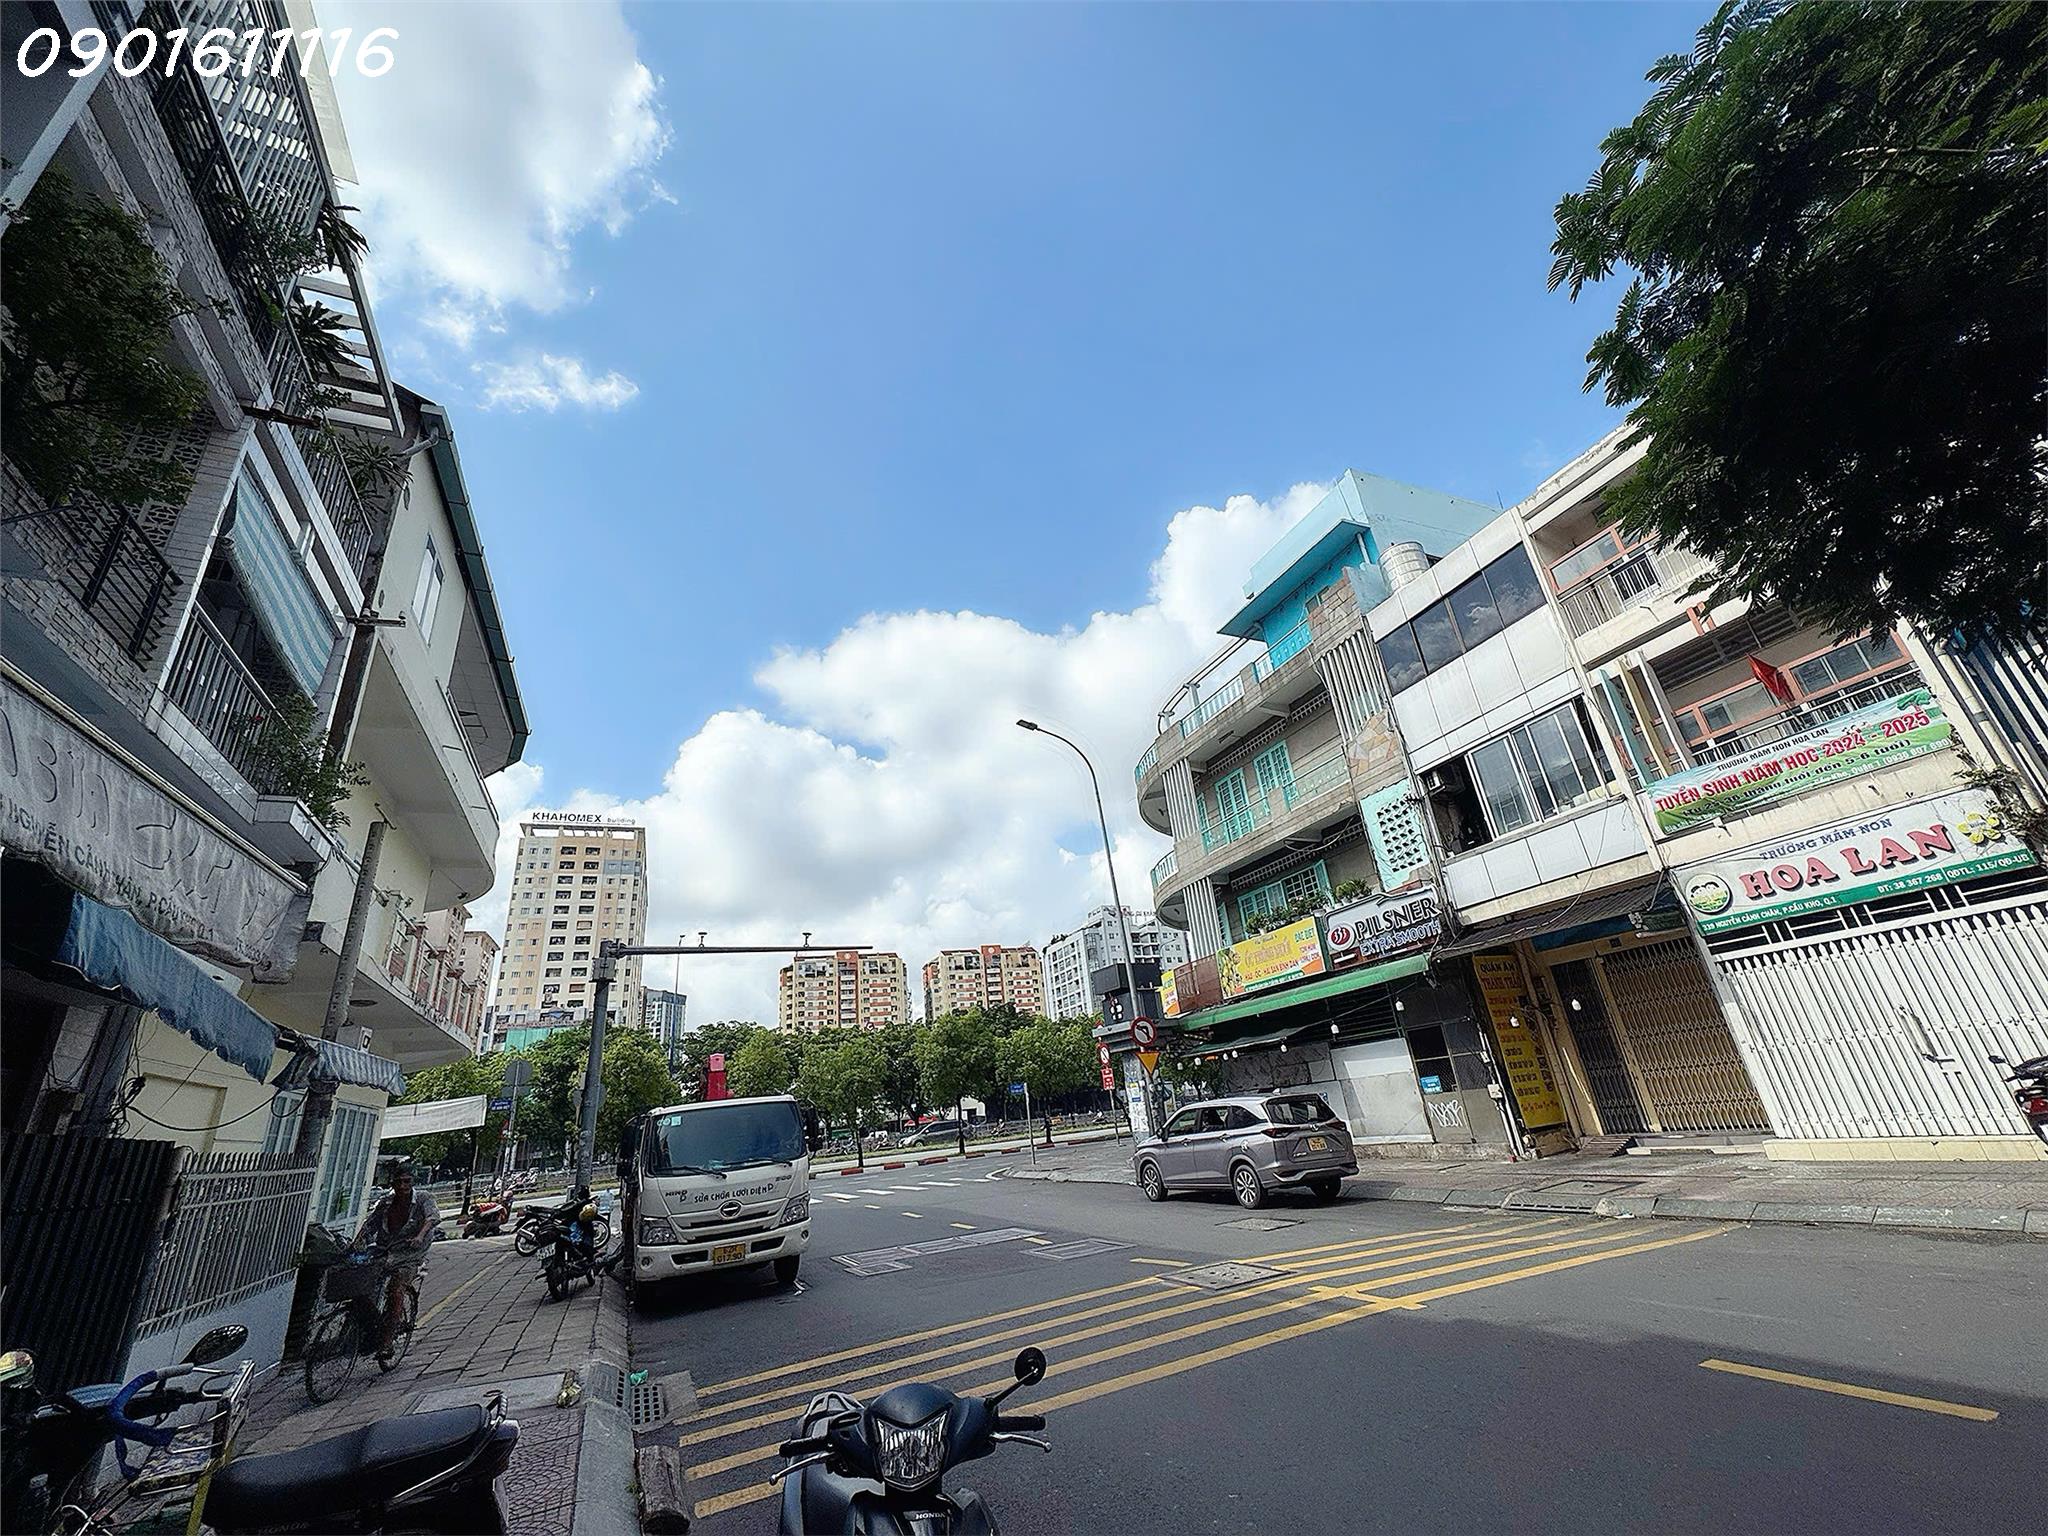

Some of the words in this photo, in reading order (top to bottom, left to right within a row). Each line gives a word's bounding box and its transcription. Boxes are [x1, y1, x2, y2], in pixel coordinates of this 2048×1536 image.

[1772, 740, 1791, 754] NON
[1791, 734, 1810, 745] HOA
[1811, 727, 1830, 738] LAN
[1656, 785, 1701, 812] TUYỂN
[1702, 773, 1742, 797] SINH
[1743, 762, 1784, 785] NĂM
[1784, 747, 1820, 770] HỌC
[1821, 733, 1867, 758] 2024
[1881, 710, 1931, 739] 2025
[532, 812, 602, 823] KHAHOMEX
[1859, 818, 1893, 834] NON
[1739, 856, 1839, 900] HOA
[1840, 823, 1955, 876] LAN
[1823, 896, 1837, 906] Q.1
[1354, 896, 1440, 941] PILSNER
[1394, 919, 1441, 947] SMOOTH
[915, 1512, 946, 1520] HONDA
